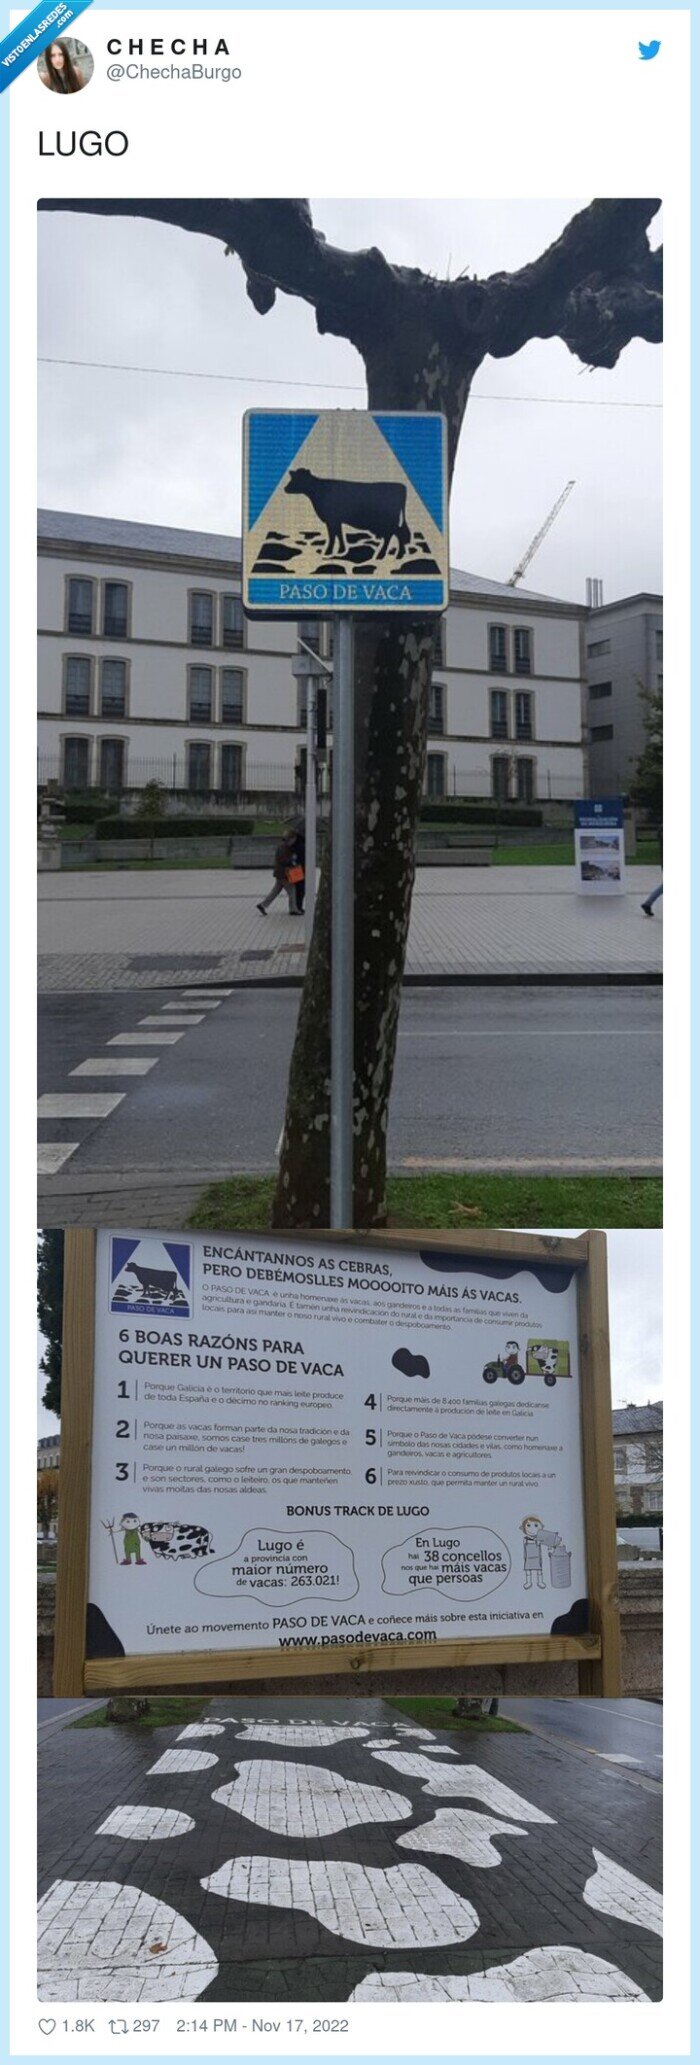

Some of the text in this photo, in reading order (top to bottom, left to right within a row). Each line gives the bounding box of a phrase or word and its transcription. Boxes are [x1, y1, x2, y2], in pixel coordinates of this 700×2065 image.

[280, 584, 412, 600] PASO DE VACA
[203, 1245, 393, 1277] ENCÁNTANNOS AS CEBRAS,
[202, 1263, 522, 1304] PERO DEBÉMOSLLES MOOOOITO MÁIS ÁS VACAS.
[119, 1329, 305, 1355] 6 BOAS RAZÓNS PARA
[118, 1350, 345, 1378] QUERER UN PASO DE VACA
[117, 1380, 130, 1399] 1
[144, 1382, 175, 1392] Porque
[177, 1383, 204, 1392] Galicia
[222, 1386, 256, 1396] territorio
[257, 1389, 273, 1397] que
[294, 1390, 311, 1399] leite
[312, 1391, 344, 1401] produce
[144, 1393, 156, 1401] de
[157, 1393, 177, 1402] toda
[179, 1394, 210, 1404] España
[226, 1396, 257, 1406] décimo
[270, 1398, 299, 1409] ranking
[300, 1401, 334, 1410] europeo.
[364, 1393, 377, 1410] 4
[115, 1420, 130, 1439] 2
[143, 1420, 175, 1431] Porque
[213, 1422, 243, 1432] forman
[244, 1425, 267, 1434] parte
[267, 1425, 278, 1433] da
[300, 1426, 332, 1436] tradición
[340, 1428, 350, 1436] da
[365, 1428, 377, 1446] 5
[206, 1444, 218, 1453] de
[219, 1445, 246, 1454] vacas!
[115, 1462, 129, 1481] 3
[143, 1463, 174, 1474] Porque
[183, 1464, 203, 1473] rural
[204, 1465, 234, 1475] galego
[235, 1465, 256, 1474] sofre
[269, 1467, 288, 1476] gran
[365, 1467, 377, 1485] 6
[168, 1474, 207, 1483] sectores,
[271, 1477, 281, 1485] os
[282, 1478, 298, 1486] que
[142, 1486, 165, 1494] vivas
[166, 1485, 194, 1494] moitas
[195, 1486, 212, 1494] das
[286, 1506, 430, 1517] BONUS TRACK DE LUGO
[257, 1539, 305, 1554] Lugo é
[415, 1538, 461, 1551] En Lugo
[251, 1554, 290, 1564] provincia
[407, 1550, 503, 1562] hai 38 concellos
[232, 1563, 328, 1576] maior número
[414, 1564, 428, 1573] que
[441, 1561, 471, 1574] máis
[473, 1564, 508, 1573] vacas
[236, 1575, 340, 1588] de vacas: 263.021!
[408, 1574, 483, 1585] que persoas
[146, 1623, 182, 1636] Únete
[184, 1625, 200, 1634] ao
[201, 1621, 270, 1633] movemento
[272, 1616, 307, 1630] PASO
[310, 1615, 329, 1628] DE
[330, 1614, 366, 1627] VACA
[376, 1614, 412, 1625] coñece
[415, 1613, 438, 1623] máis
[440, 1612, 467, 1623] sobre
[468, 1612, 487, 1622] esta
[489, 1610, 531, 1621] iniciativa
[532, 1612, 544, 1620] en
[278, 1629, 437, 1648] www.pasodevaca.com
[203, 1716, 412, 1729] PASO DE VACA
